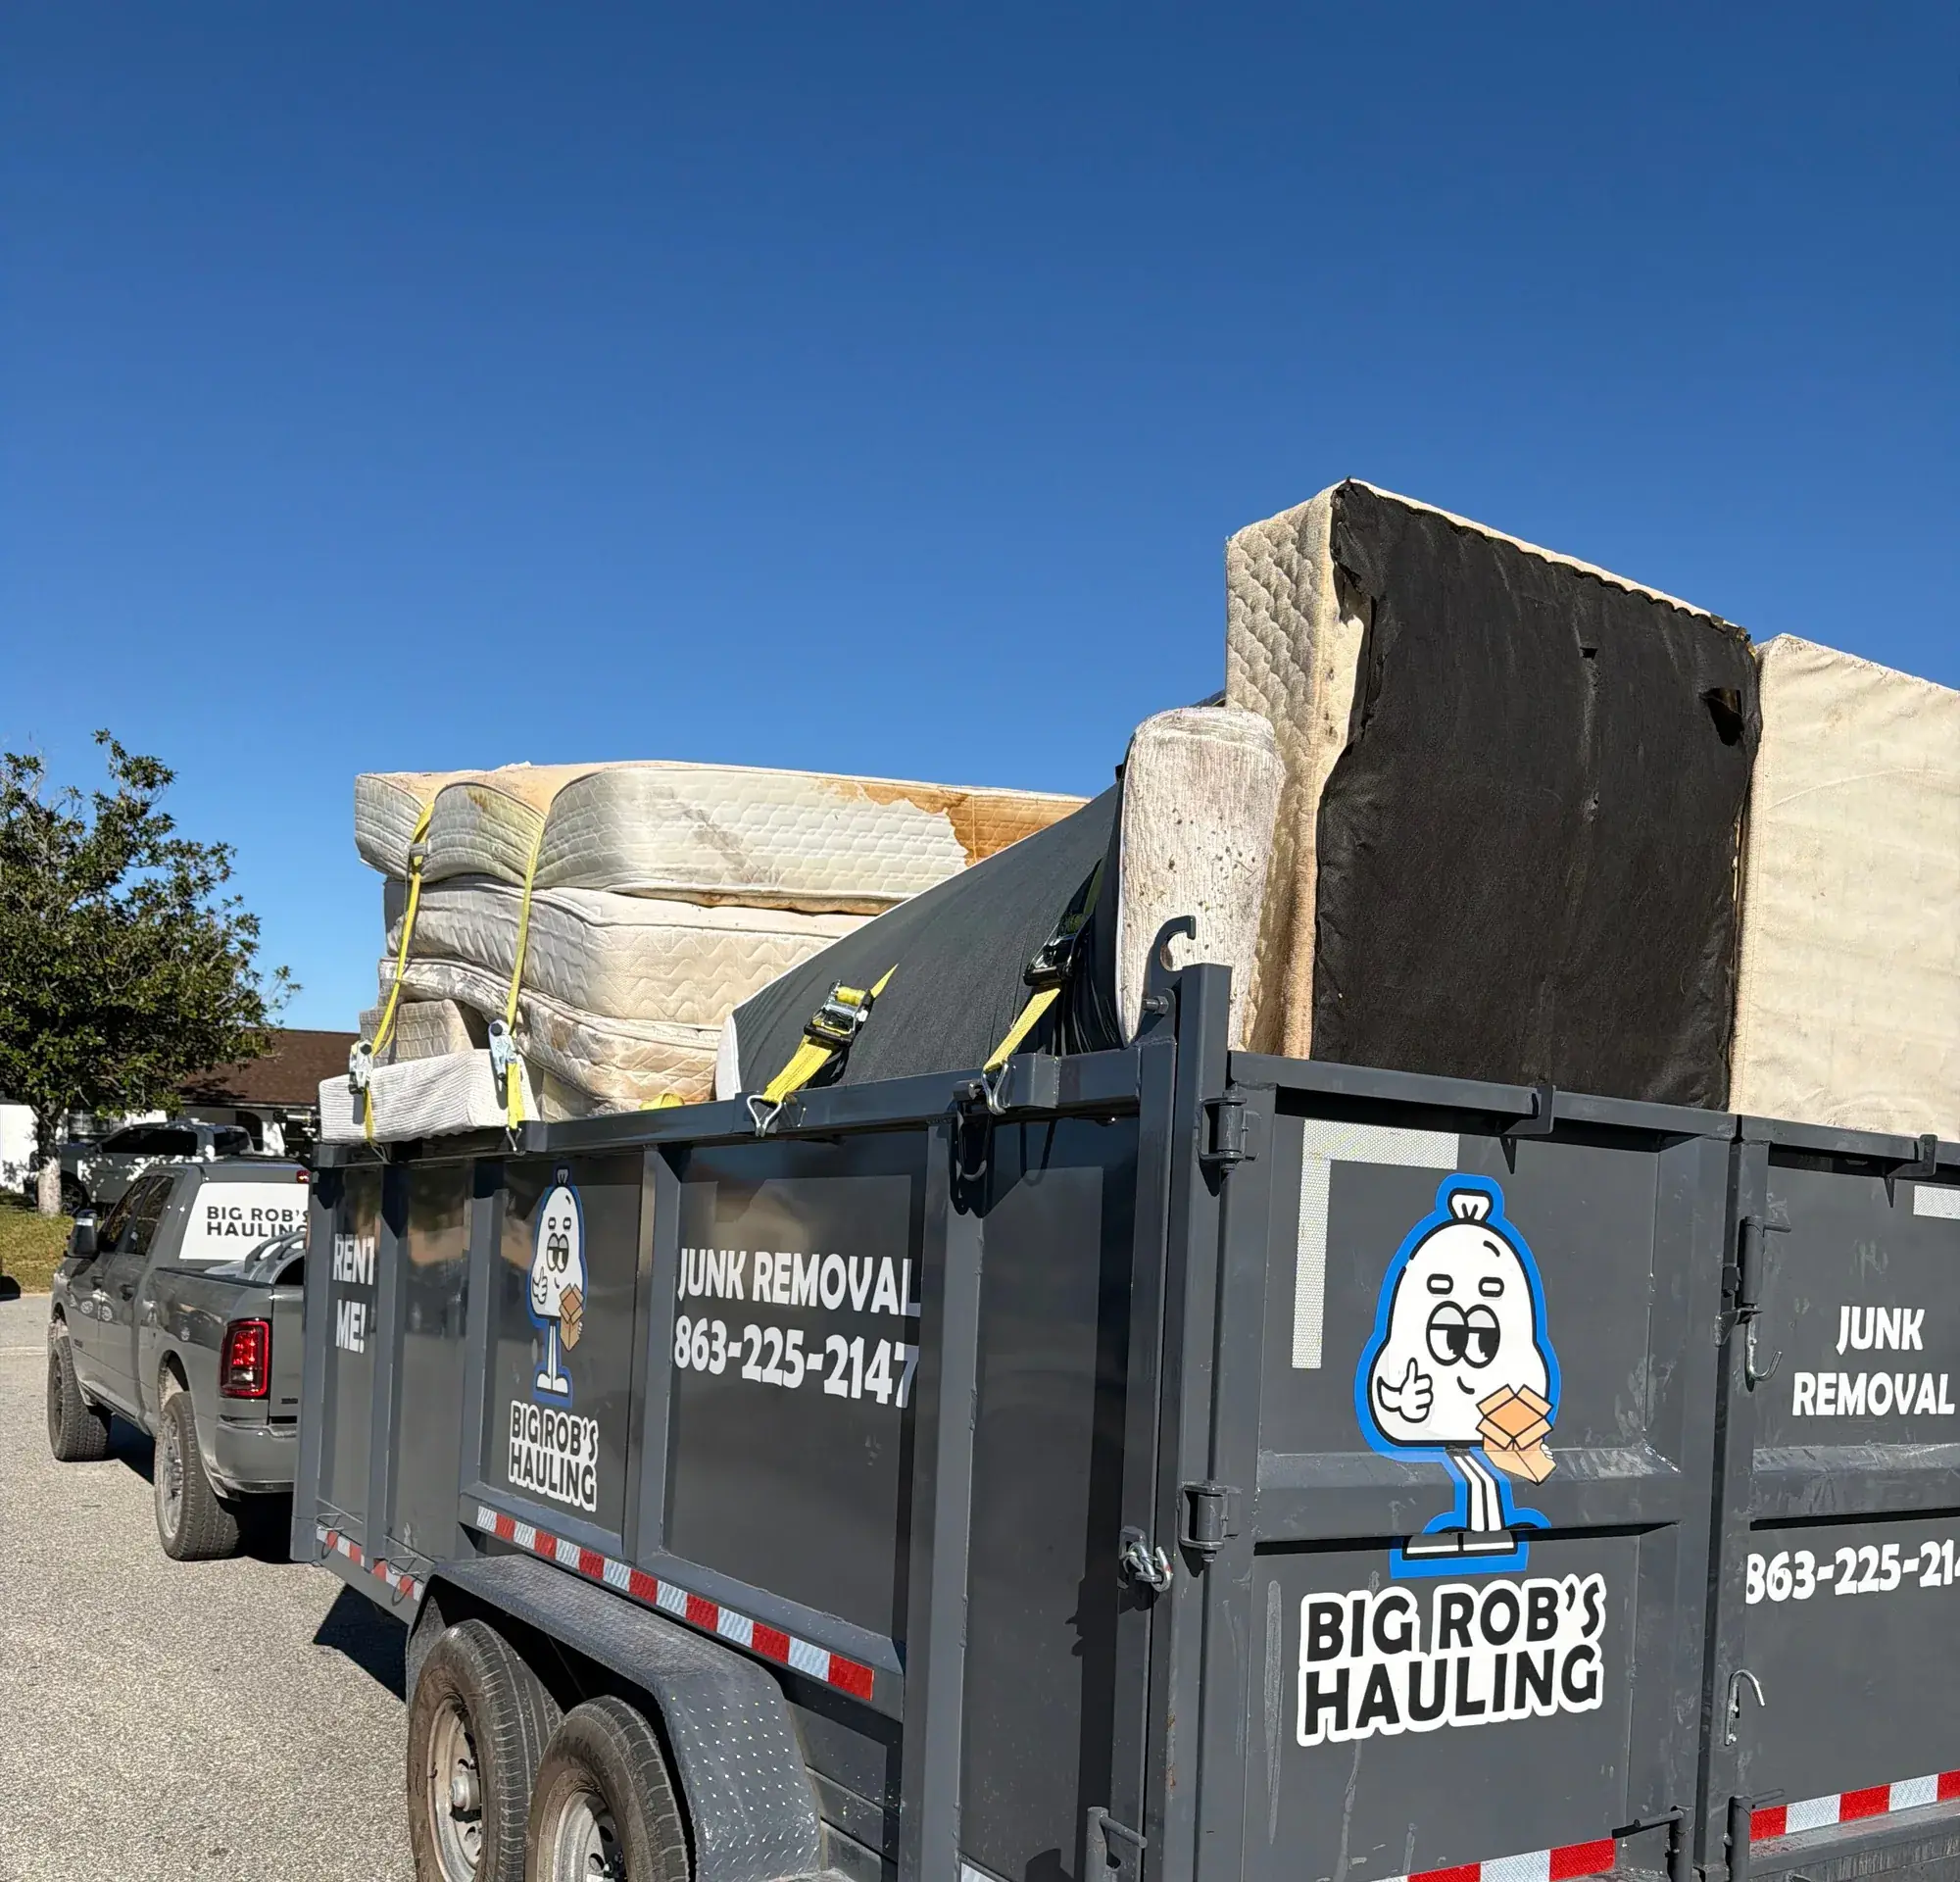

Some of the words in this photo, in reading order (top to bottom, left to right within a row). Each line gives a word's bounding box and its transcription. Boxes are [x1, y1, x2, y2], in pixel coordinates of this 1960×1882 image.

[207, 1206, 242, 1220] BIG
[332, 1233, 375, 1286] RENT
[677, 1247, 747, 1302] JUNK
[752, 1251, 921, 1317] REMOVAL
[335, 1299, 367, 1354] ME!
[1836, 1306, 1925, 1355] JUNK
[674, 1314, 919, 1409] 863-225-2147
[1791, 1372, 1956, 1416] REMOVAL
[512, 1405, 539, 1444] BIG
[544, 1412, 597, 1461] ROB'S
[510, 1442, 596, 1505] HAULING
[1745, 1539, 1960, 1605] 863-225-21
[1307, 1595, 1413, 1662] BIG
[1439, 1581, 1600, 1650] ROB'S
[1304, 1644, 1597, 1736] HAULING
